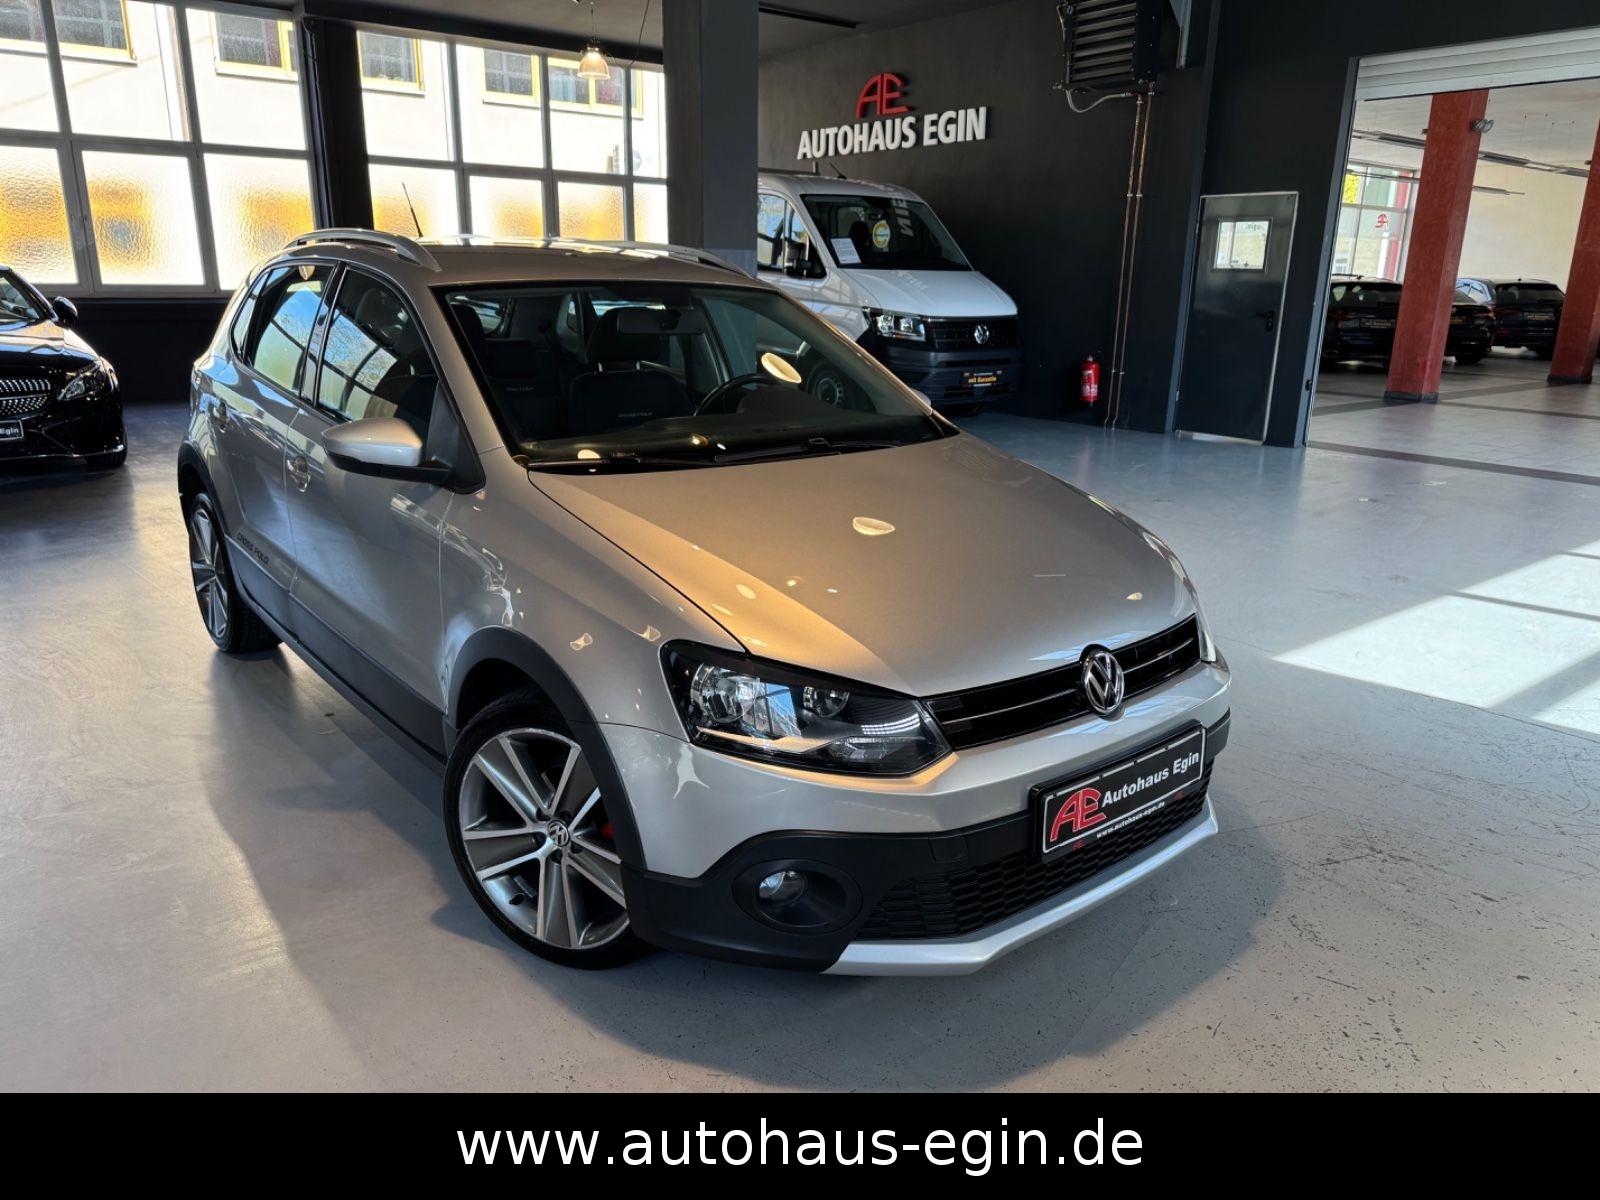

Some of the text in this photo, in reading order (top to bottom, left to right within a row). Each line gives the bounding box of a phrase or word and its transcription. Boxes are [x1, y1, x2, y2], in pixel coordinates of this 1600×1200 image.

[797, 106, 987, 160] AUTOHAUS EGIN
[1101, 752, 1200, 808] Autohaus Egin
[1096, 801, 1166, 839] www.autohaus-egin.de
